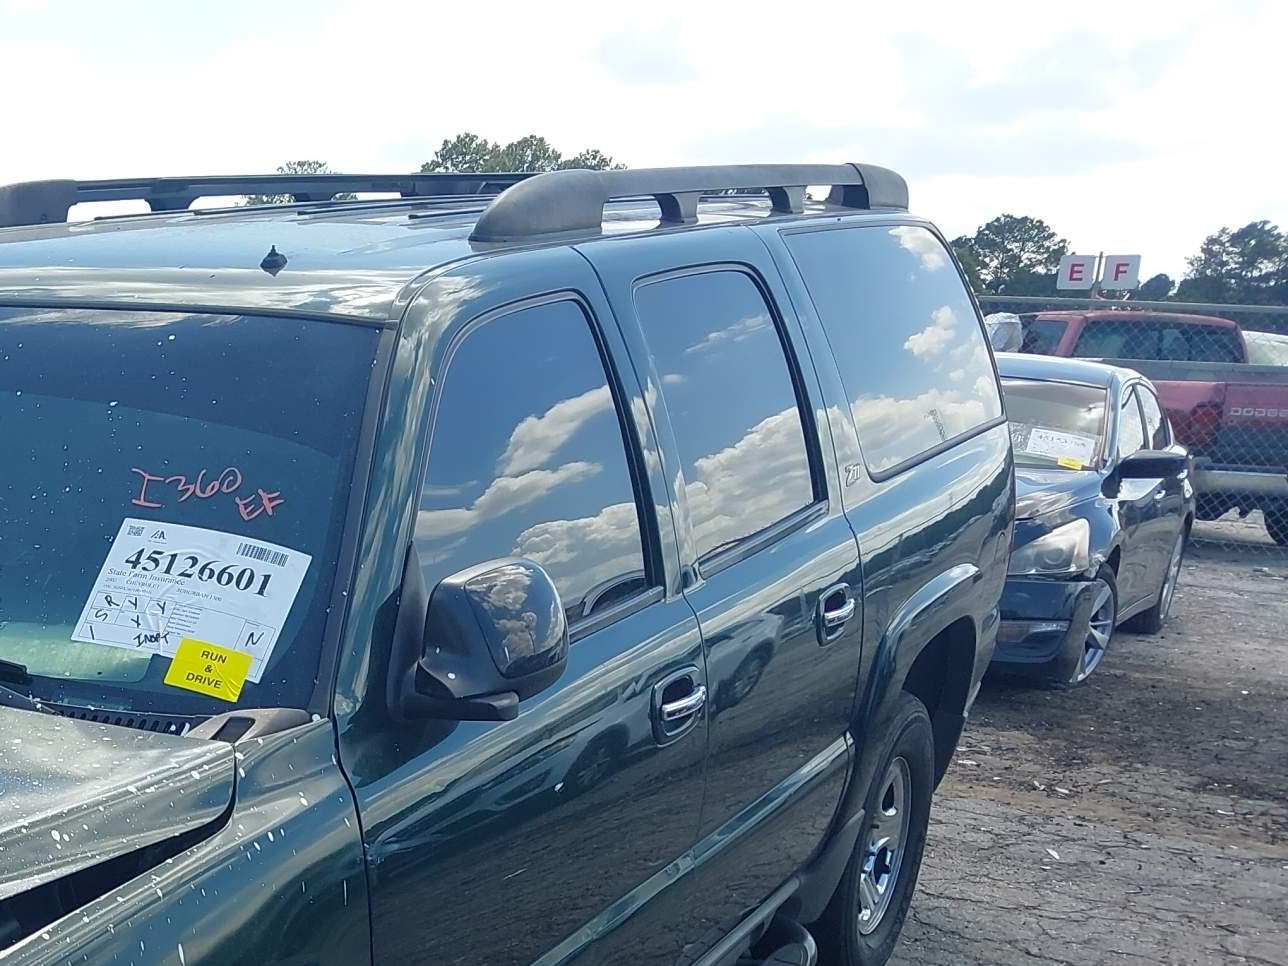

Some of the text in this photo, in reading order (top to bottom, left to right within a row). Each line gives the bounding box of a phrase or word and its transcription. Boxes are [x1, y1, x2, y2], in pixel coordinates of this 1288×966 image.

[1069, 263, 1085, 281] E
[1113, 263, 1130, 281] F
[124, 547, 273, 598] 45126601
[200, 650, 228, 664] RUN
[204, 664, 214, 673] &
[185, 672, 223, 689] DRIVE
